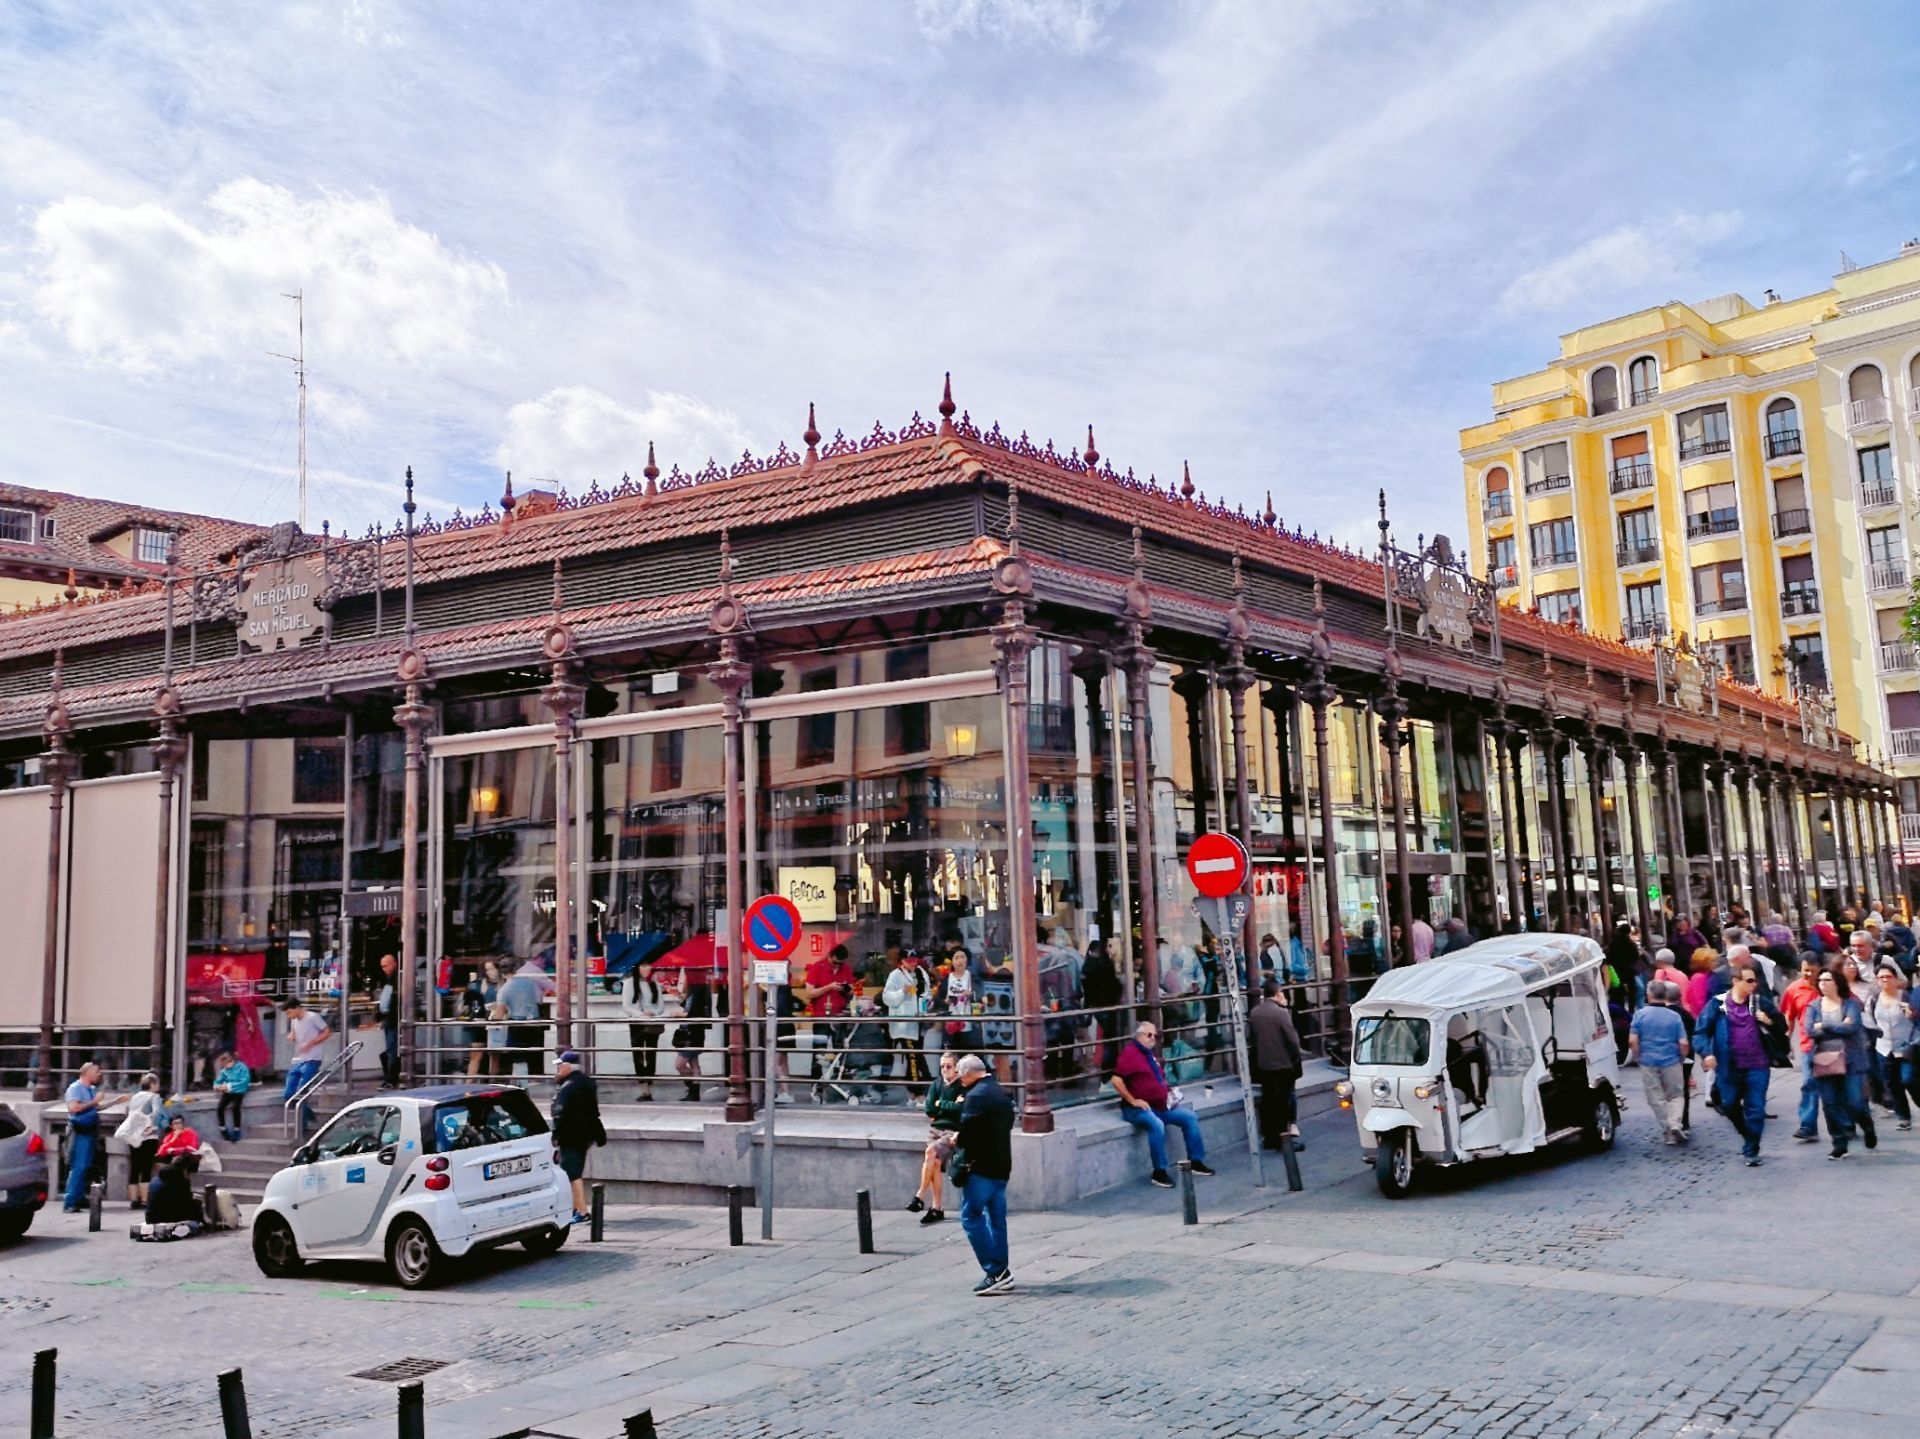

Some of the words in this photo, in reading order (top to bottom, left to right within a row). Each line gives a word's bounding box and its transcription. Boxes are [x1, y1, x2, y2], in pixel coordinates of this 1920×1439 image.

[252, 583, 309, 607] MERCADO
[272, 604, 288, 616] DE
[249, 620, 270, 637] SAN
[272, 613, 312, 633] MIGUEL
[816, 793, 850, 806] Frutas
[653, 804, 706, 819] Margaritas
